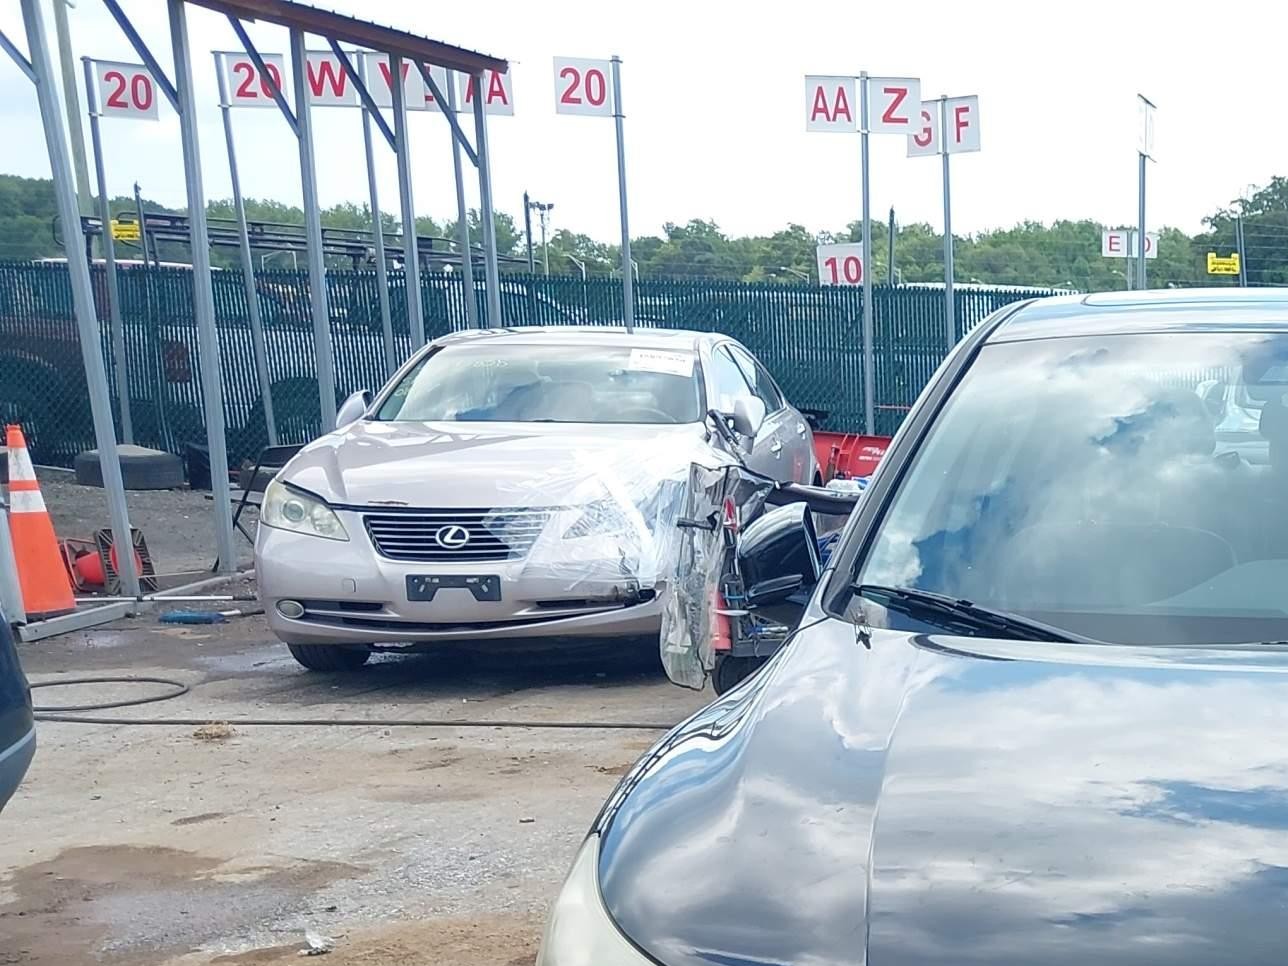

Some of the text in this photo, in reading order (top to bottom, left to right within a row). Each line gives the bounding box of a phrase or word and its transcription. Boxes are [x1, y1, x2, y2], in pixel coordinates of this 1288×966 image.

[104, 71, 152, 110] 20
[233, 62, 282, 99] 20
[306, 61, 347, 97] W
[559, 67, 606, 106] 20
[811, 86, 852, 122] AA
[882, 87, 909, 124] Z
[955, 106, 970, 144] F
[1109, 235, 1121, 252] E
[825, 256, 862, 285] 10
